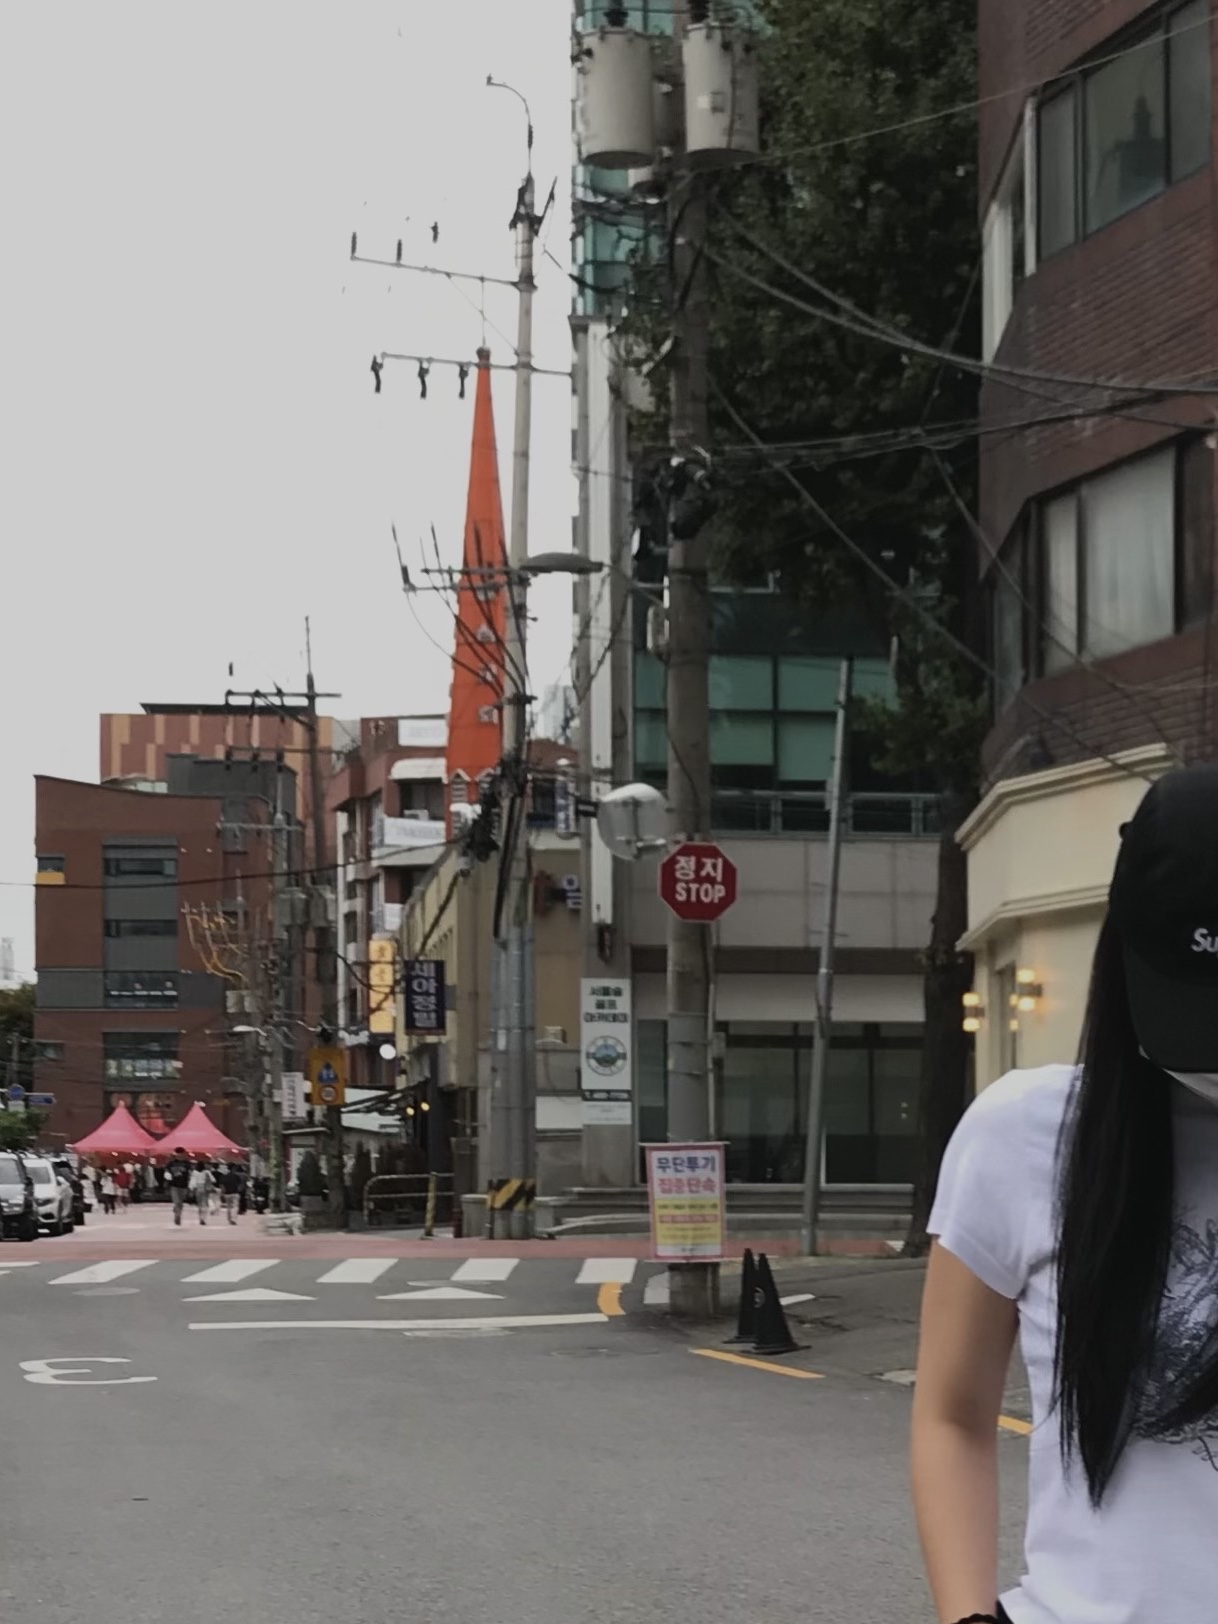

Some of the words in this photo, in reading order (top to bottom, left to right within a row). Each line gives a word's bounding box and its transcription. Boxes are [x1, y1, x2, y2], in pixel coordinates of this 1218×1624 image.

[674, 855, 723, 882] 정지
[674, 882, 726, 903] STOP
[656, 1155, 717, 1174] 무단투기
[657, 1176, 717, 1195] 집중단속
